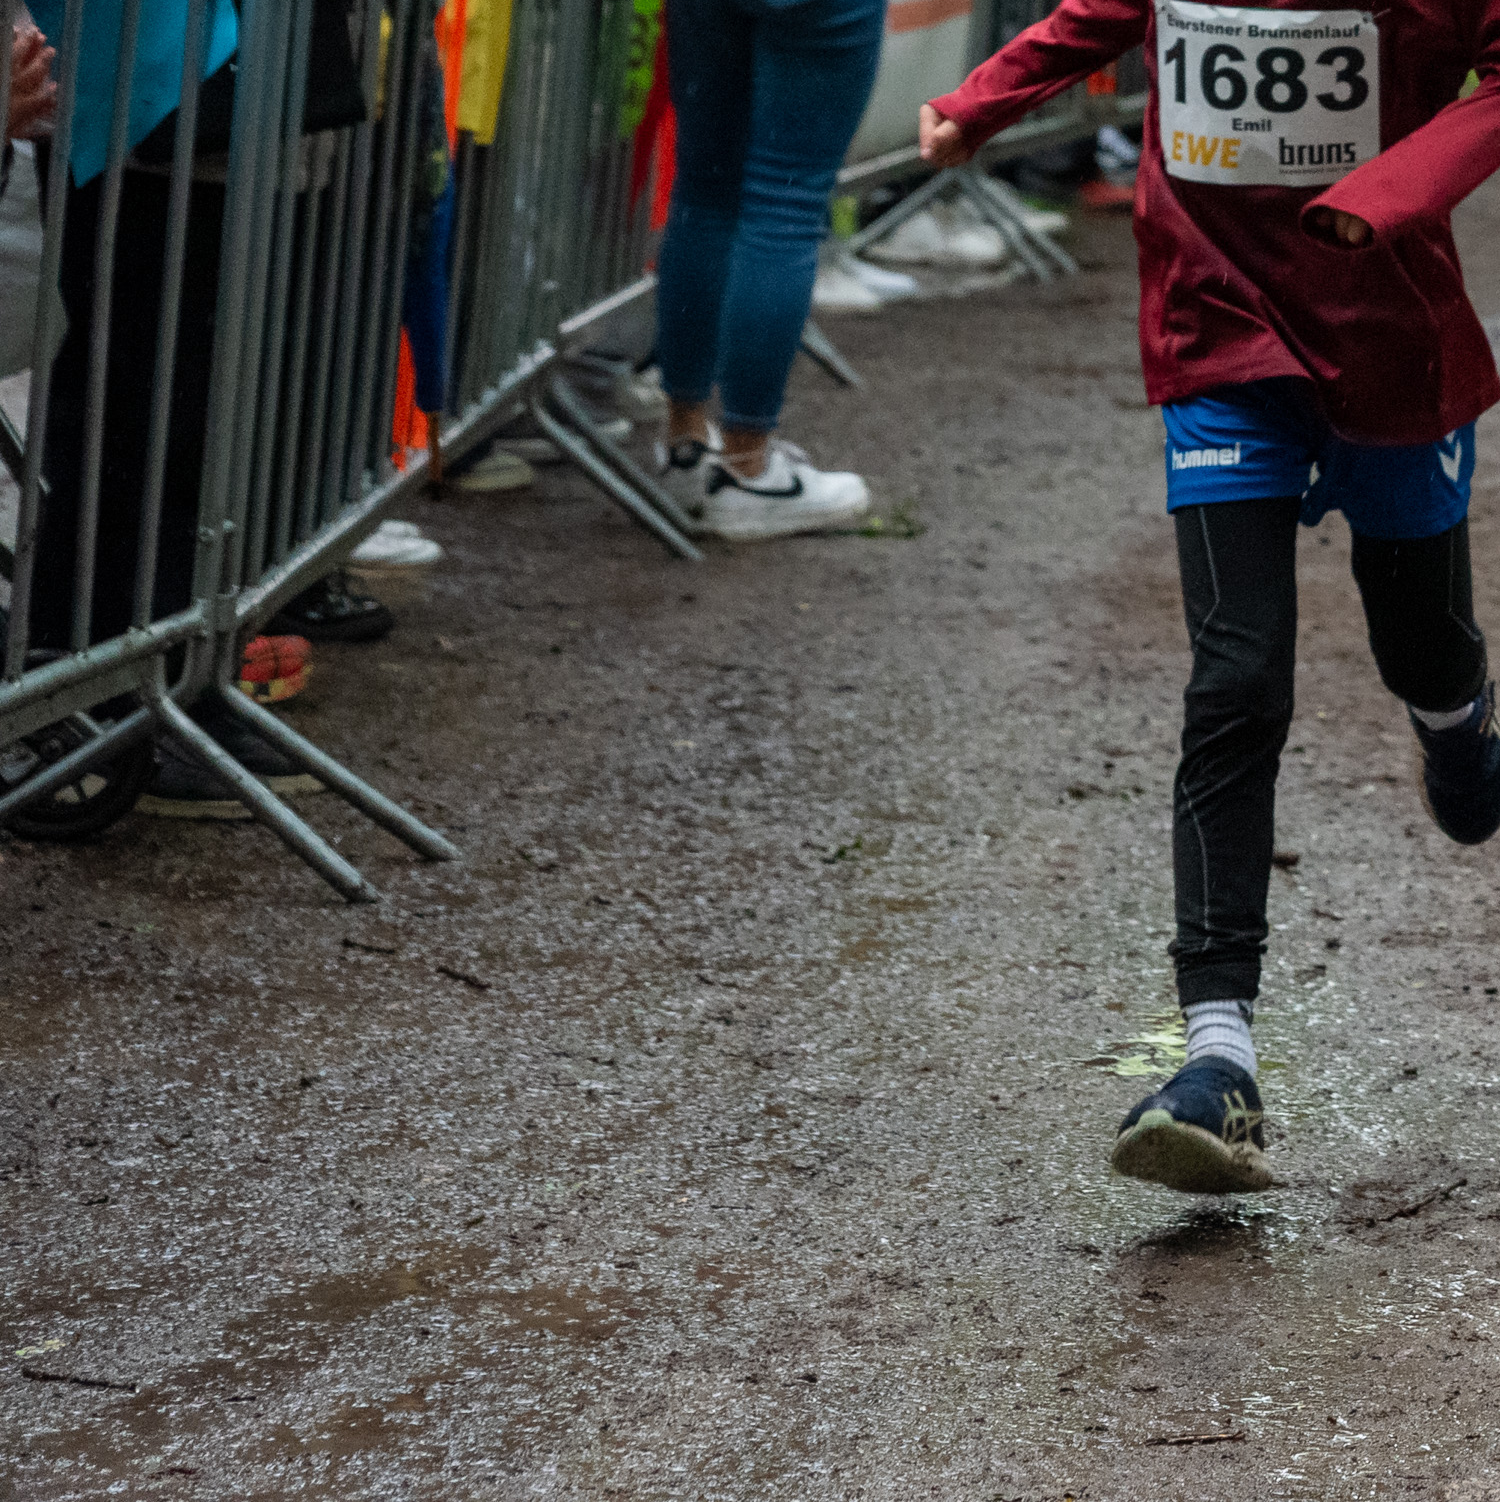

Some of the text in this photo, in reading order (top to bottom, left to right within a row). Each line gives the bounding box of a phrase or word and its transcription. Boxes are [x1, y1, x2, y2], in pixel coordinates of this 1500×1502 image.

[1248, 23, 1361, 40] Brunnenlauf
[1164, 37, 1369, 114] 1683
[1231, 117, 1273, 132] Emil
[1172, 130, 1242, 169] EWE
[1279, 137, 1356, 166] bruns
[1172, 441, 1242, 471] hummel
